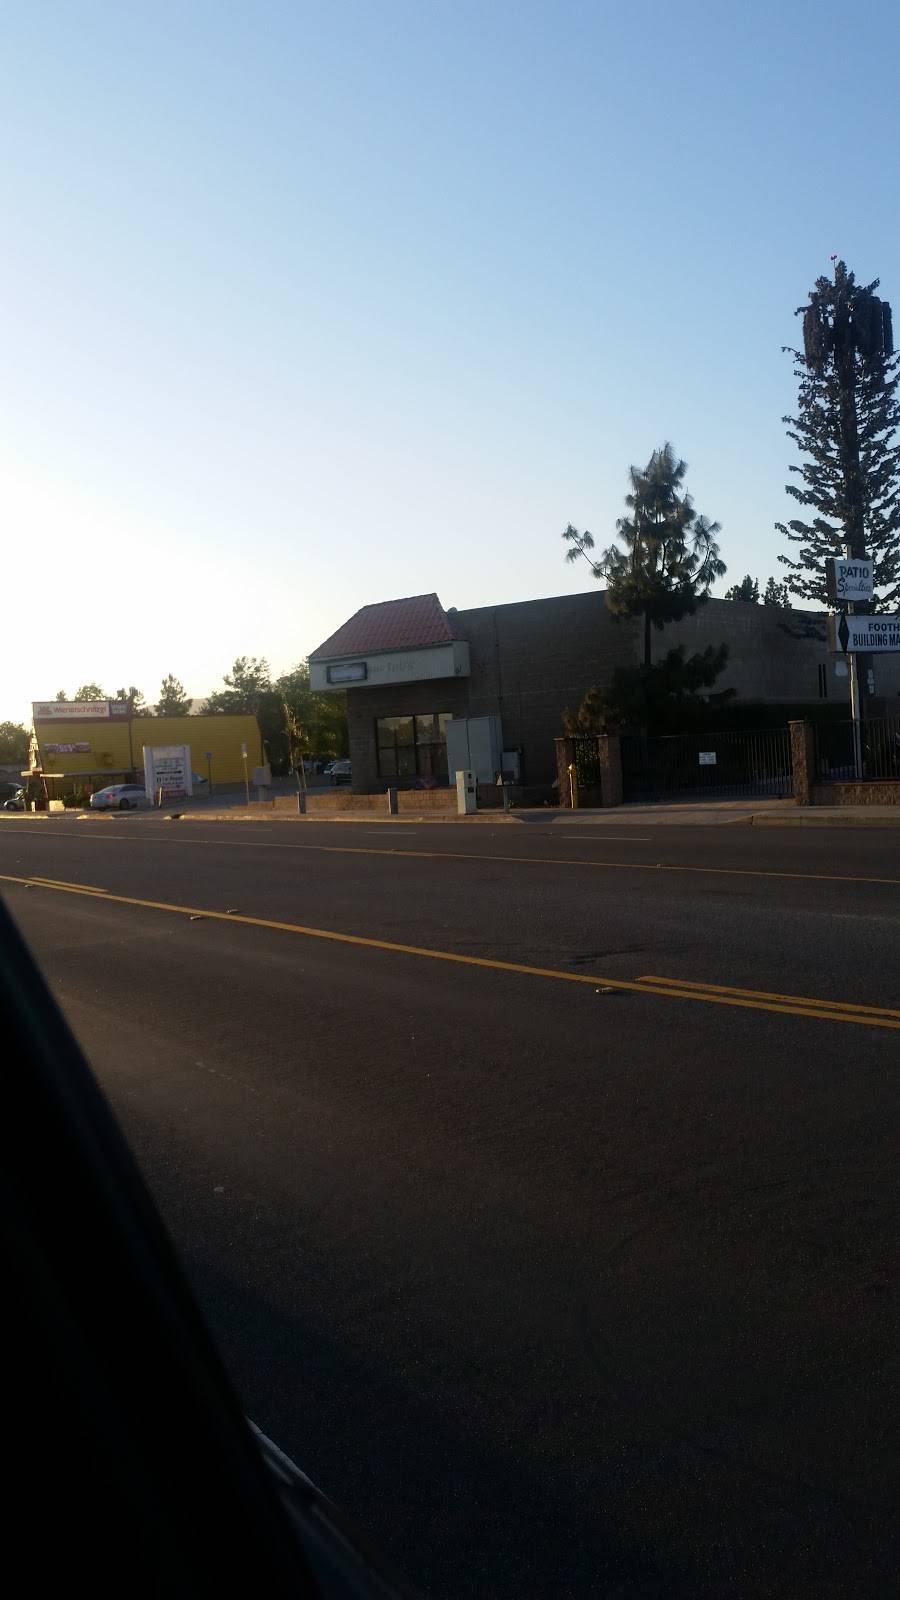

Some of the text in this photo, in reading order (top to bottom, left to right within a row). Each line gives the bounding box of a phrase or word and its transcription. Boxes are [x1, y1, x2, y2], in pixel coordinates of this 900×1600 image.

[838, 566, 869, 578] PATIO
[868, 623, 900, 632] FOOTH
[853, 634, 887, 646] BUILDING
